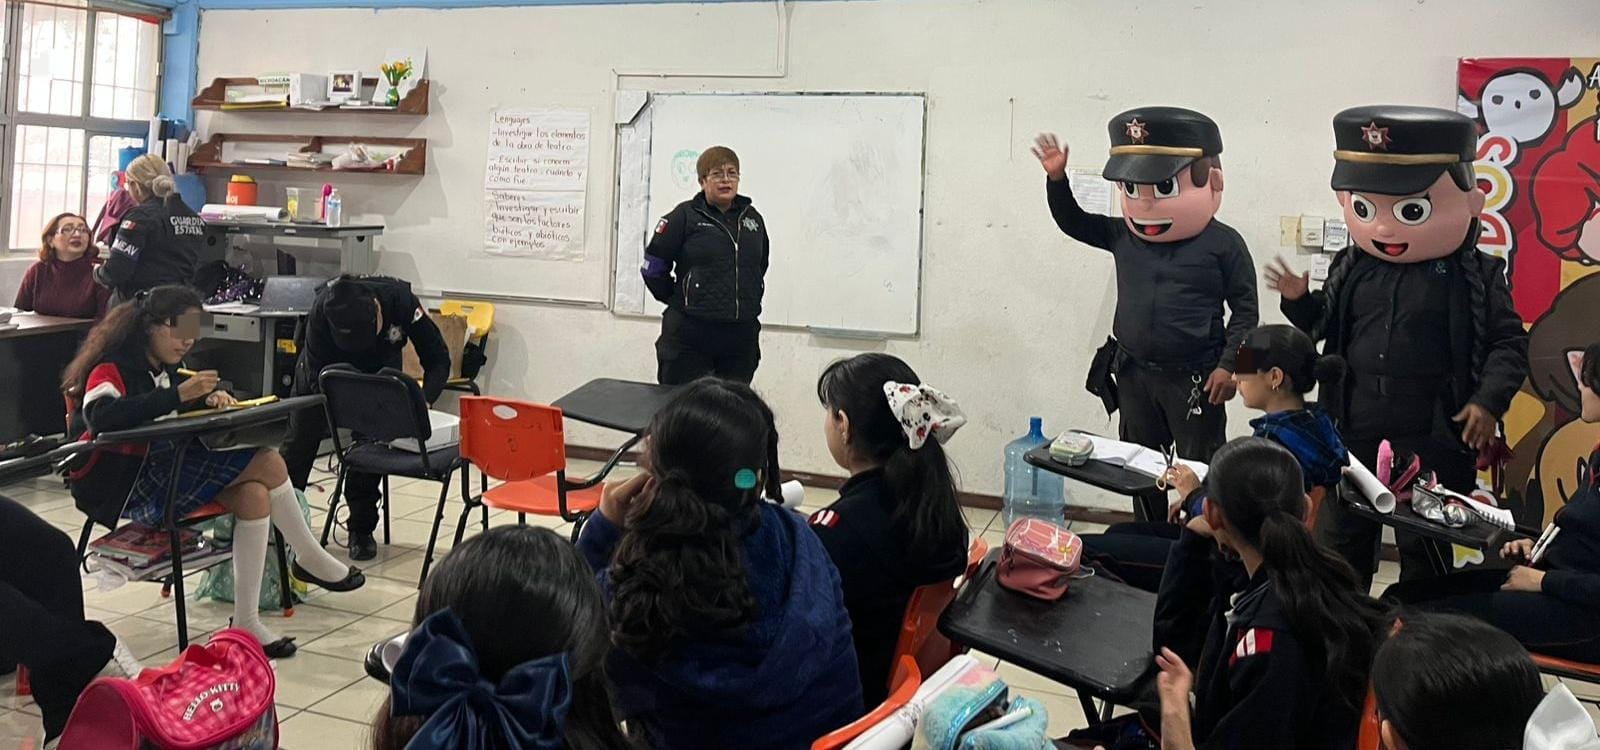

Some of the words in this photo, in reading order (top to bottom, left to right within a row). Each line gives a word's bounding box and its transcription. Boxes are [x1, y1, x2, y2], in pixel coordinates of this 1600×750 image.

[494, 112, 530, 126] Lenguajes
[536, 127, 548, 138] los
[551, 128, 585, 140] elementos
[492, 138, 500, 147] de
[505, 139, 514, 148] la
[517, 141, 532, 150] obra
[534, 141, 543, 149] de
[491, 191, 526, 201] Saberes
[170, 215, 205, 226] GUARDIA
[537, 215, 571, 228] factores
[175, 225, 204, 235] ESTATAL
[528, 231, 533, 240] y
[491, 235, 507, 244] con
[183, 691, 209, 720] HELLO
[209, 682, 239, 695] KITTY
